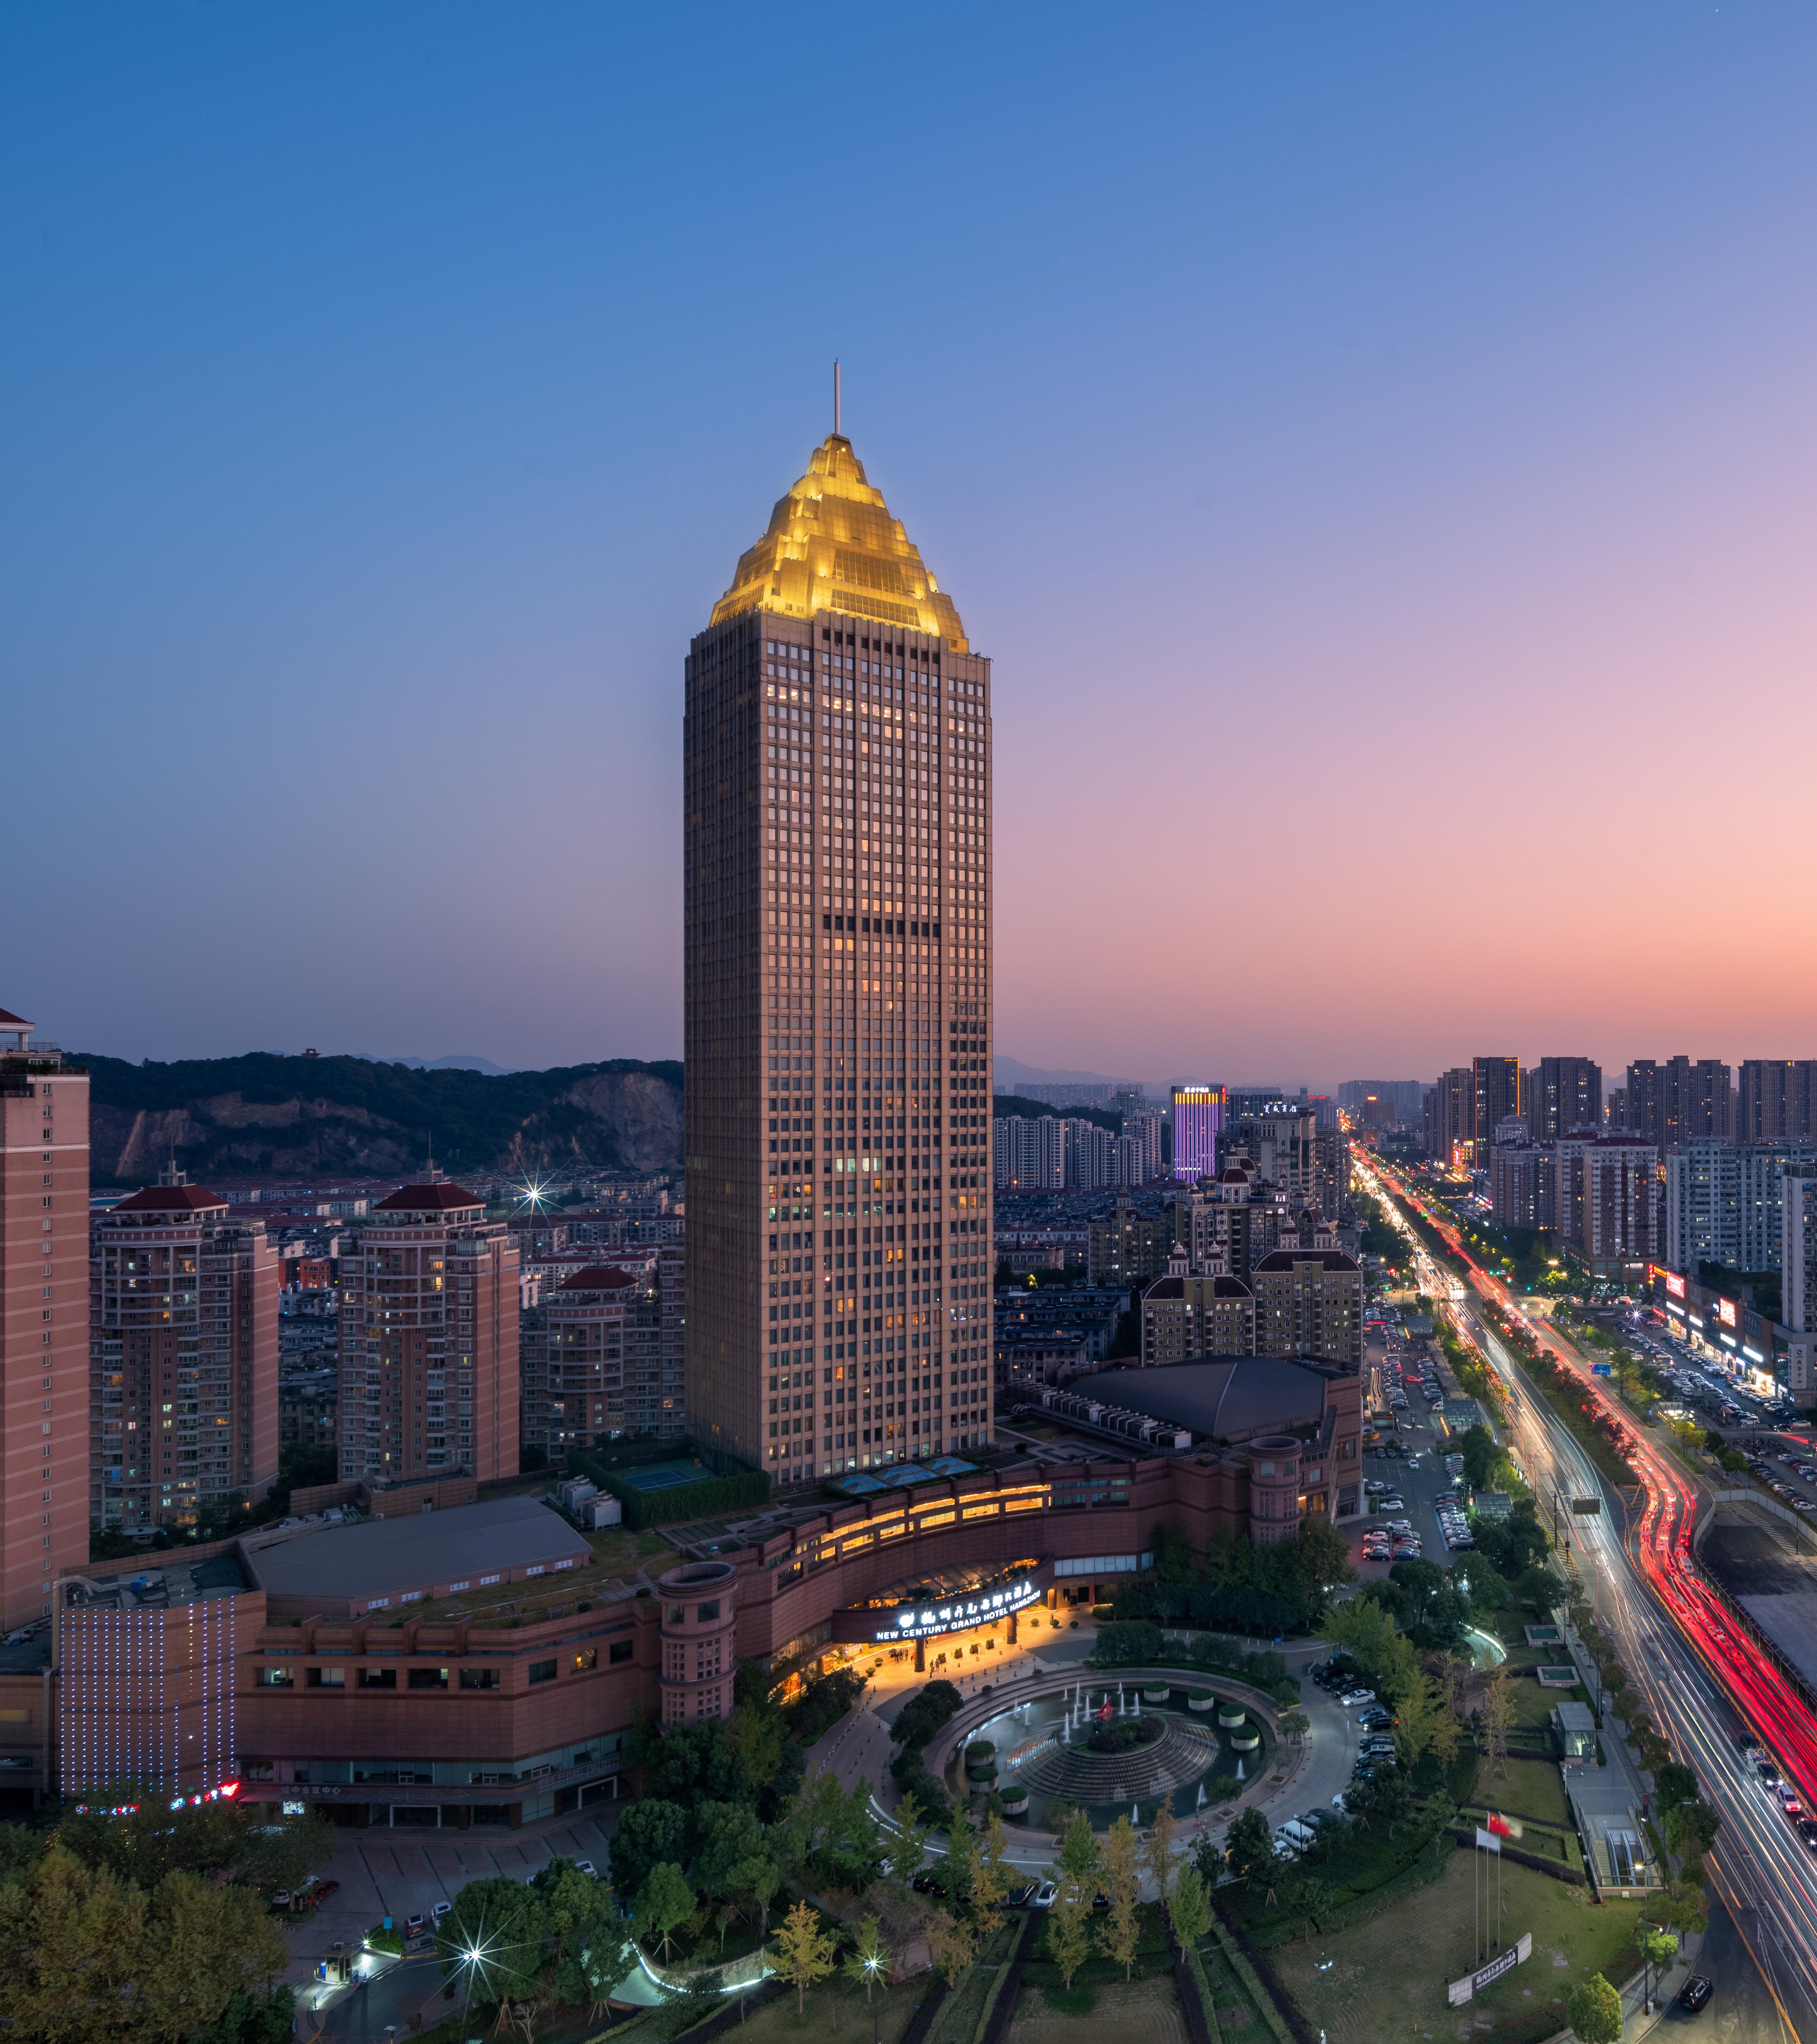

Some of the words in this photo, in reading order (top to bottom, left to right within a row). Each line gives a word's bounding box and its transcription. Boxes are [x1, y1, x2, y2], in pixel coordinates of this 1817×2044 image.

[903, 1624, 947, 1637] CENTURY
[951, 1617, 981, 1629] GRAND
[984, 1608, 1008, 1621] HOTEL
[1010, 1590, 1041, 1612] HANGZHOU
